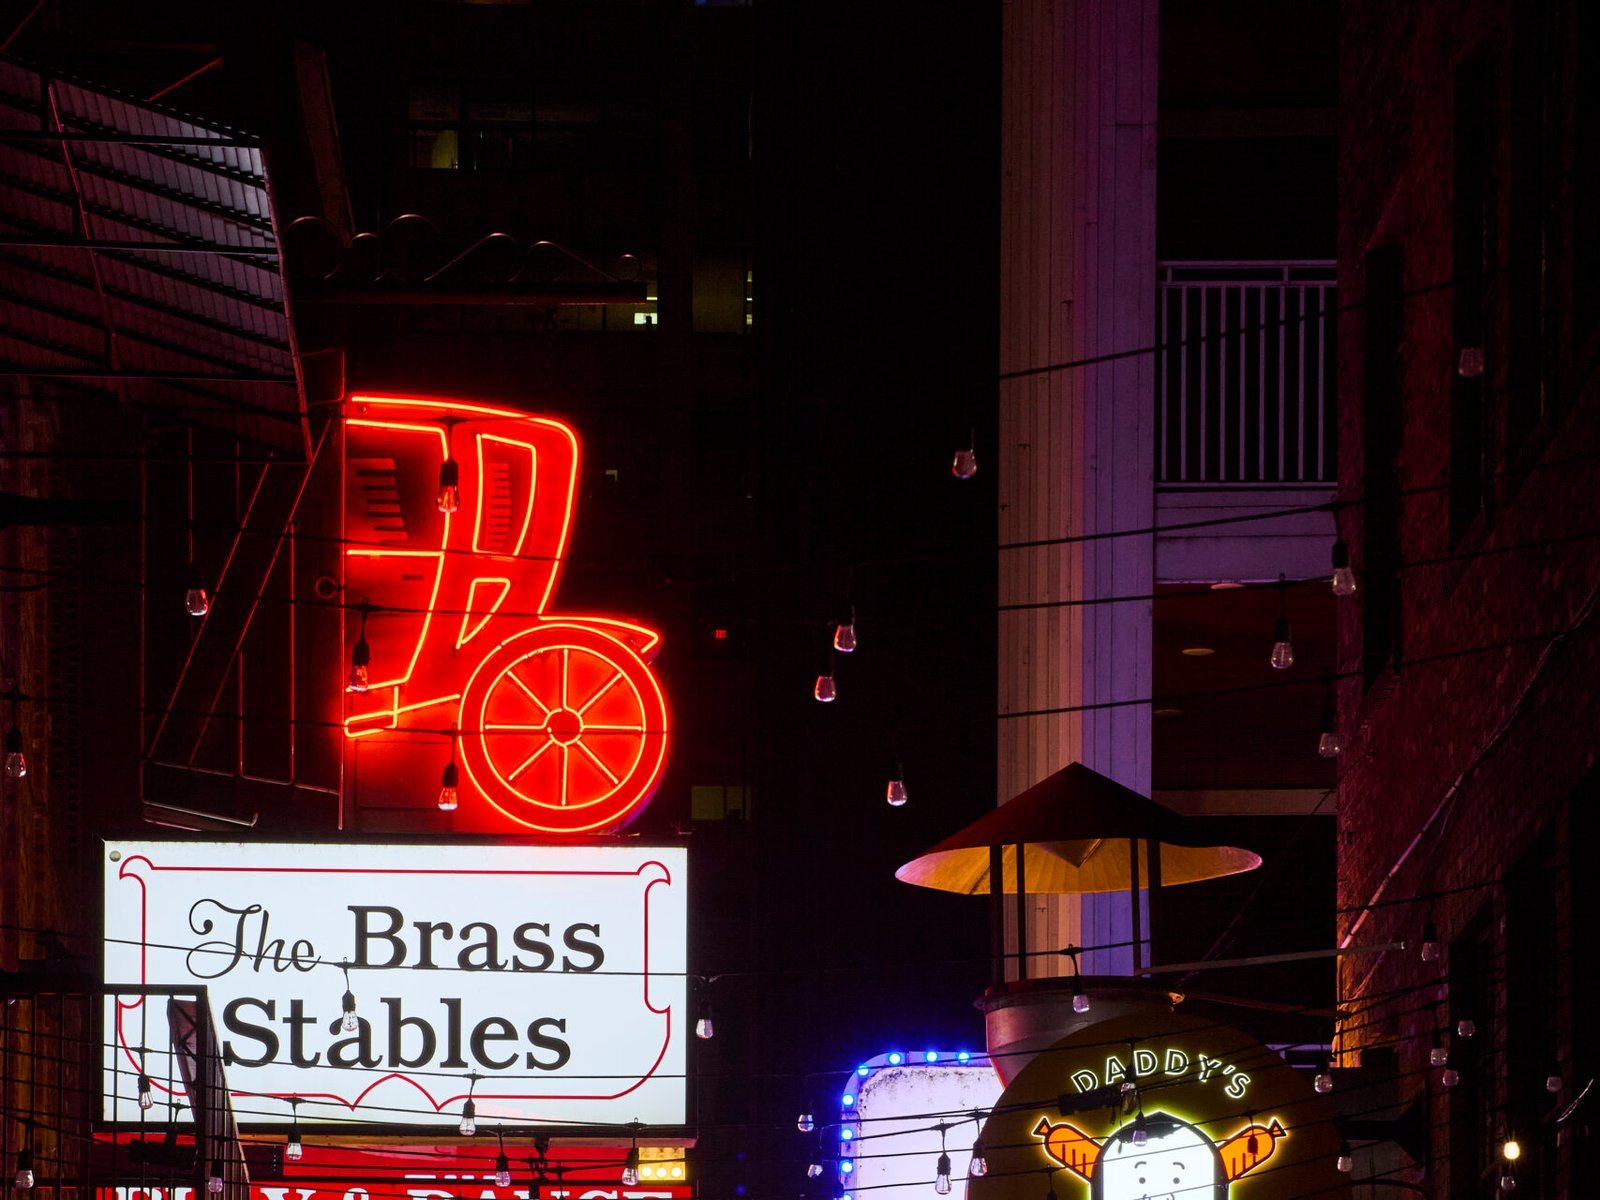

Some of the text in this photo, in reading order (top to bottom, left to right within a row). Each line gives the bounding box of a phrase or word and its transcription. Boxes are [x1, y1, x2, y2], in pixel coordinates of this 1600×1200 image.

[186, 898, 604, 979] The Brass
[223, 997, 571, 1071] Stables
[1070, 1049, 1251, 1099] DADDY'S
